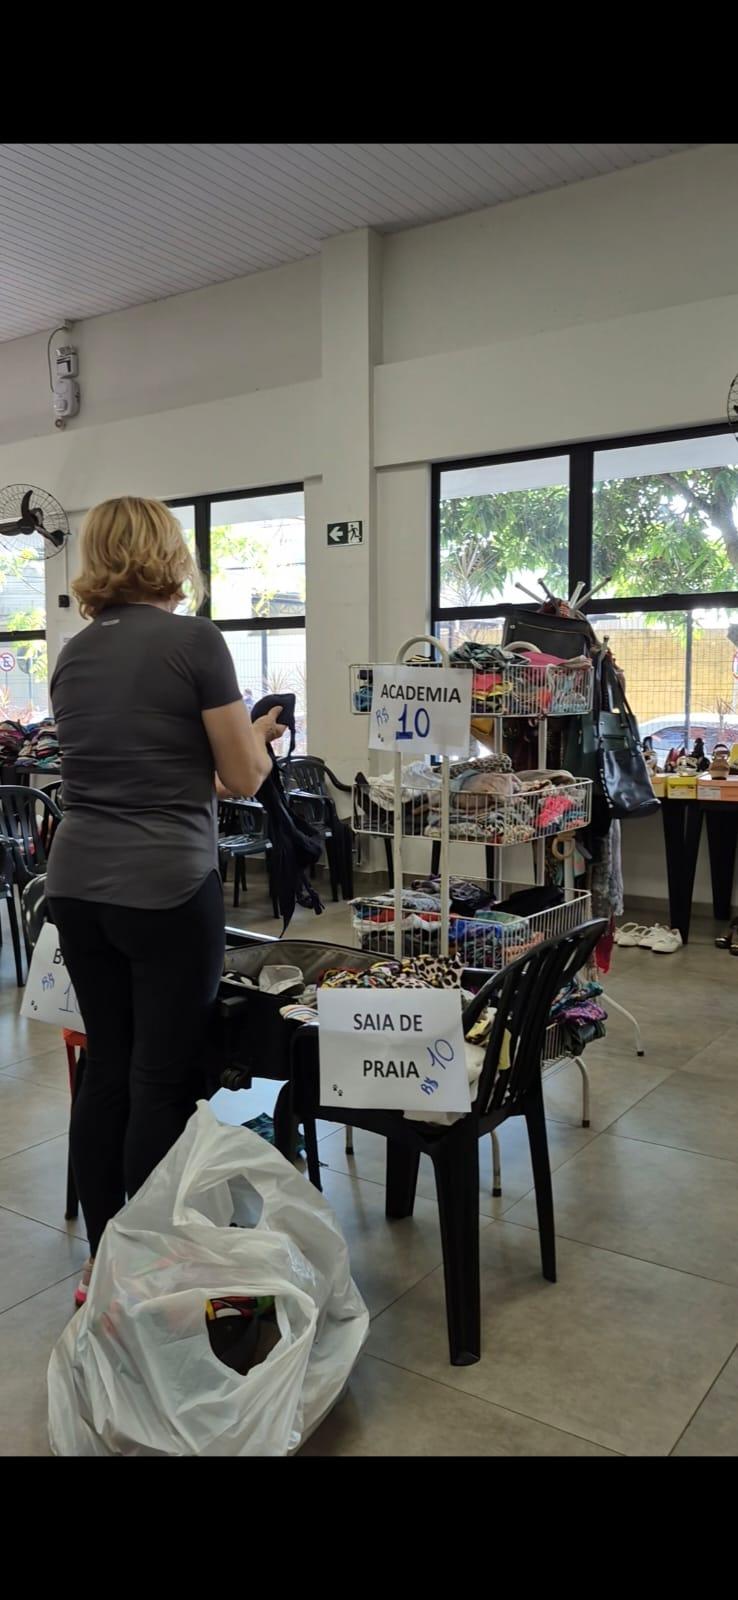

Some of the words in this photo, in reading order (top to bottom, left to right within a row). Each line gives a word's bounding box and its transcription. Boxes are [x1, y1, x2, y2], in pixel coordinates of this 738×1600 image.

[380, 684, 461, 703] ACADEMIA
[375, 706, 389, 726] R$
[395, 703, 430, 740] 10
[353, 1013, 395, 1031] SAIA
[400, 1014, 423, 1032] DE
[426, 1039, 454, 1070] 10
[363, 1059, 420, 1079] PRAIA
